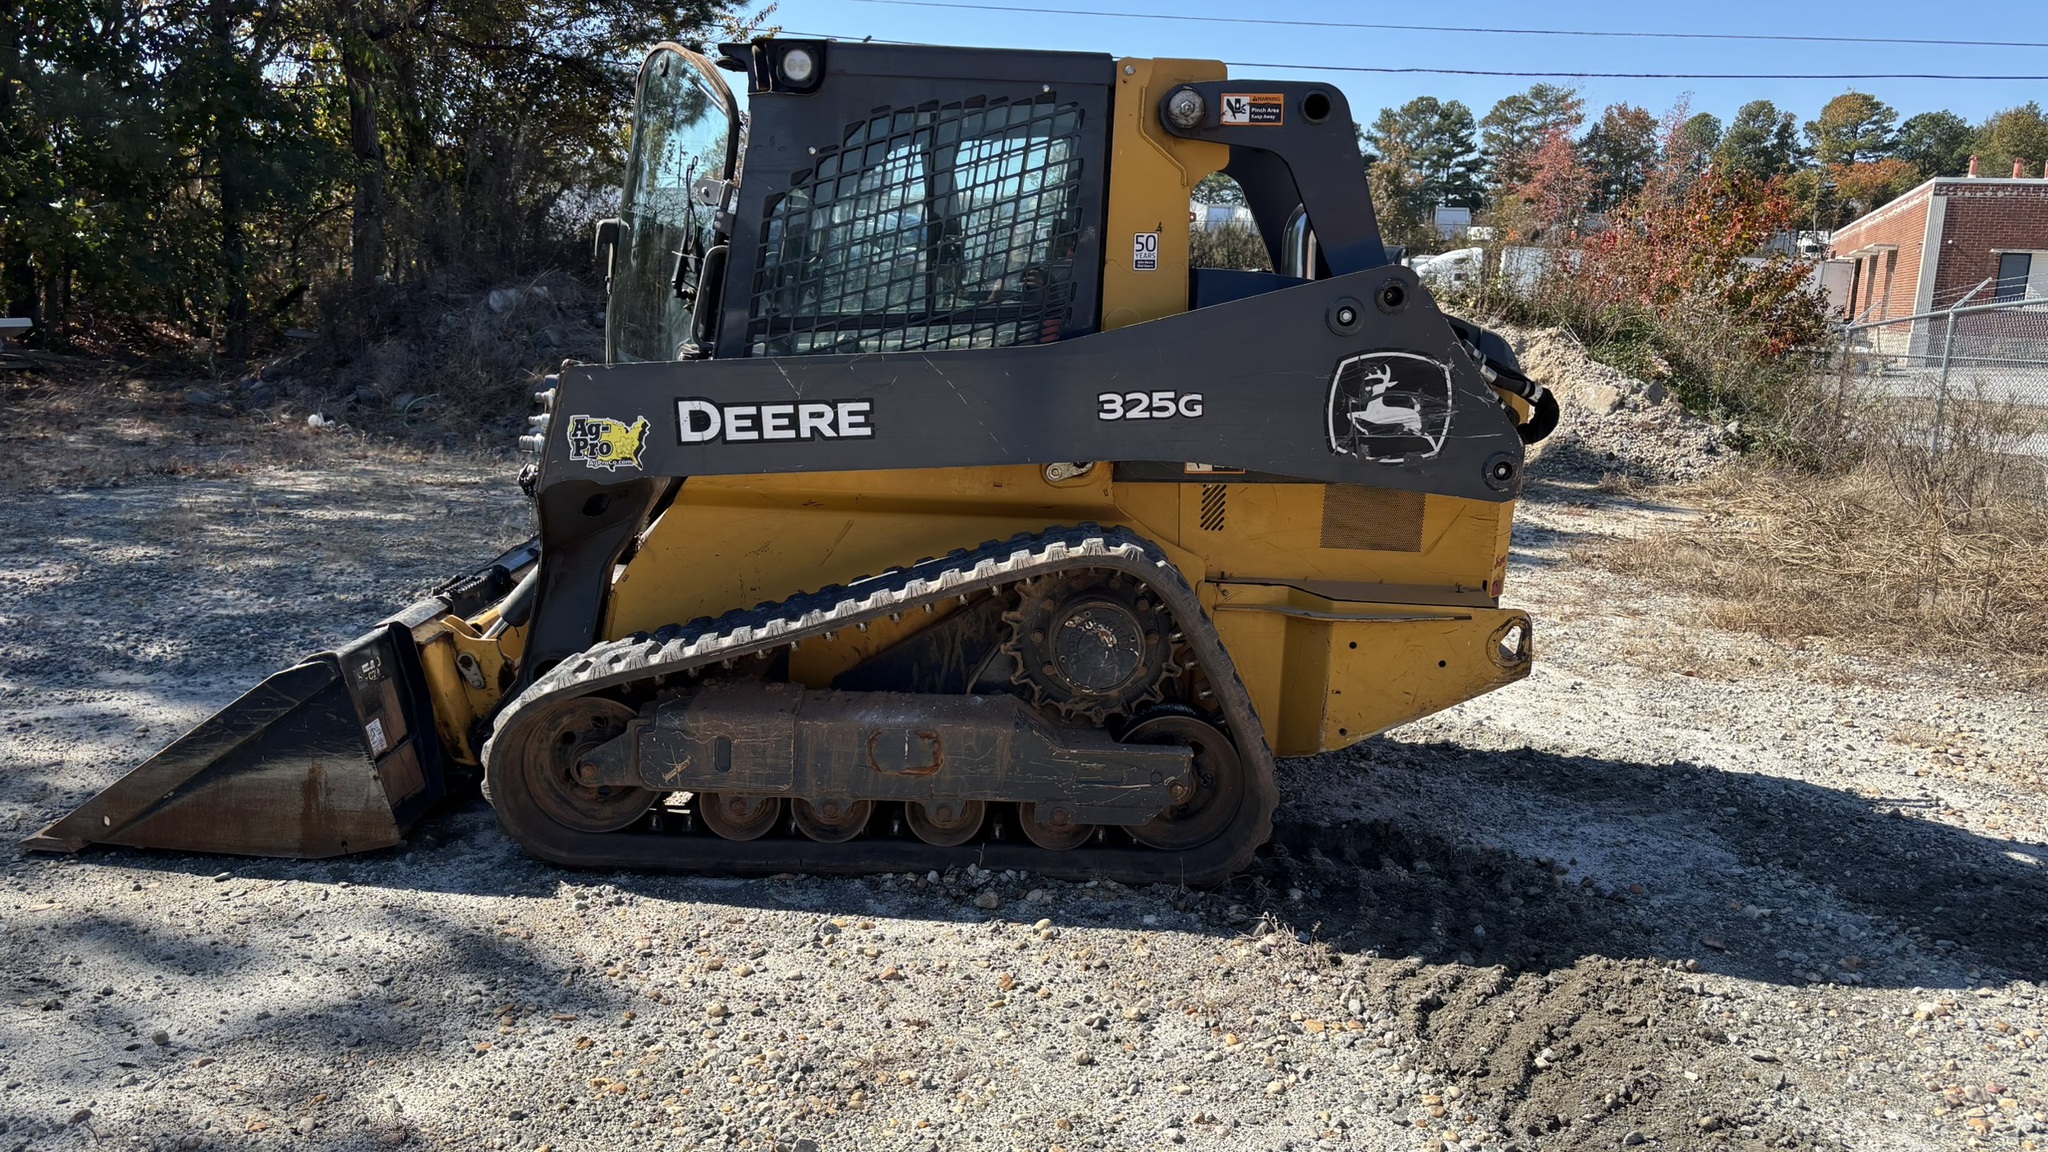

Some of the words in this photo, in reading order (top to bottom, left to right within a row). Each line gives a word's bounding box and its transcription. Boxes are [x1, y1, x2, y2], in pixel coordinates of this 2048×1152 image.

[1135, 234, 1156, 252] 50
[1098, 391, 1203, 420] 325G
[678, 401, 872, 442] DEERE
[573, 438, 612, 457] Pro
